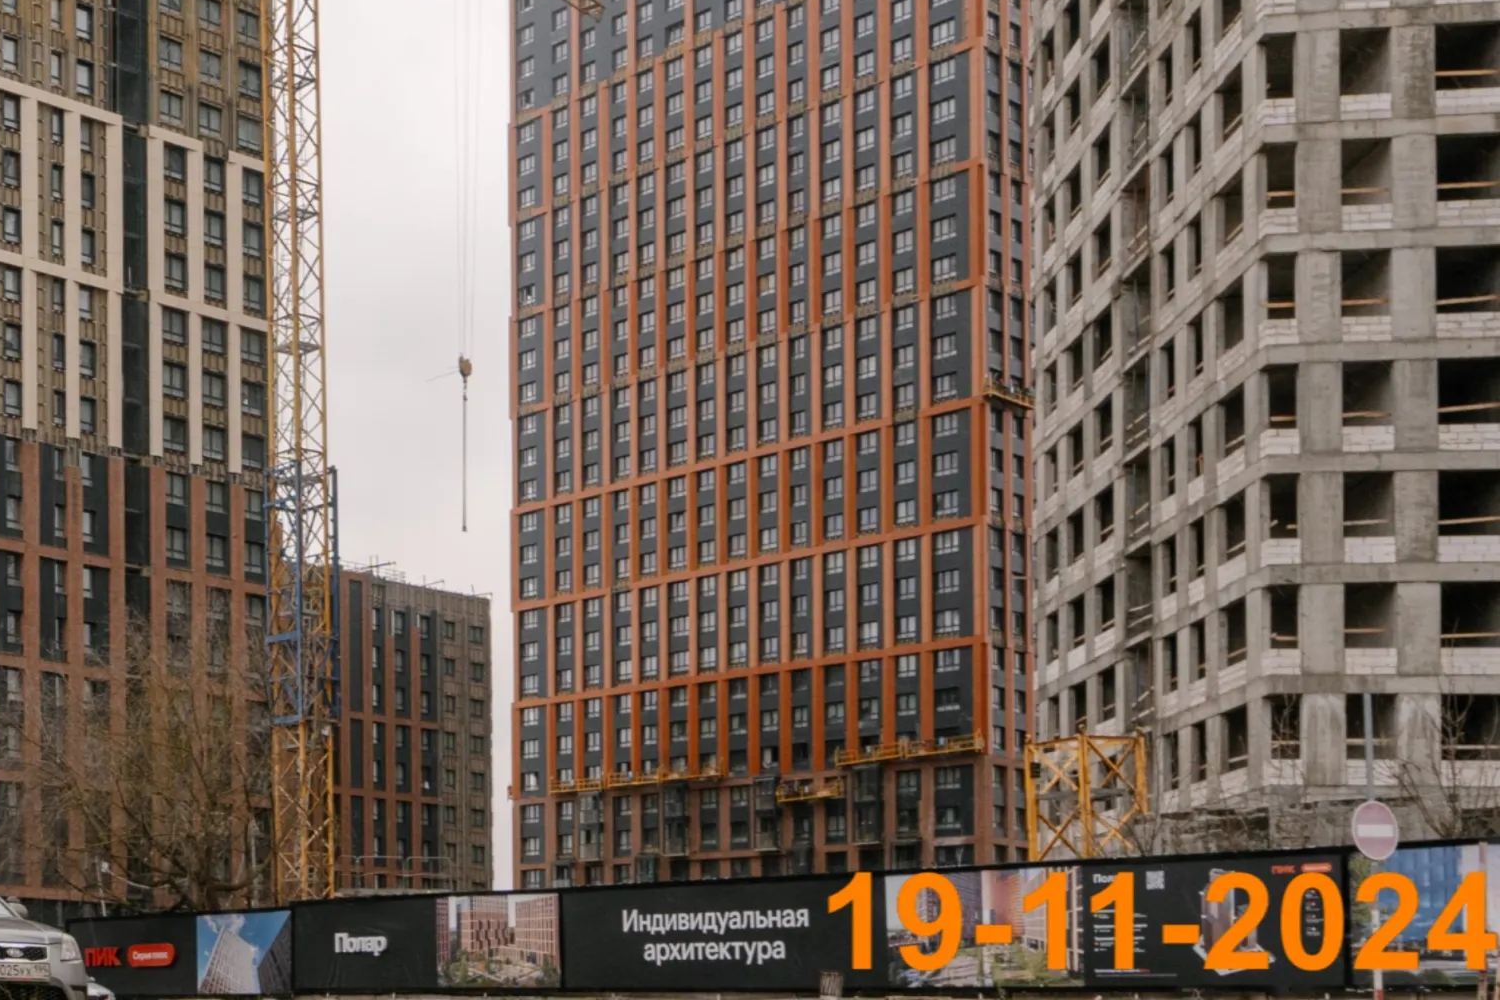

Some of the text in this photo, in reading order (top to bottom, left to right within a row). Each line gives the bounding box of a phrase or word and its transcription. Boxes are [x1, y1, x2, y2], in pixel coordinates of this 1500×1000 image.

[621, 908, 810, 936] Индивидуальная
[84, 946, 122, 967] ПИК
[643, 940, 787, 967] архитектура
